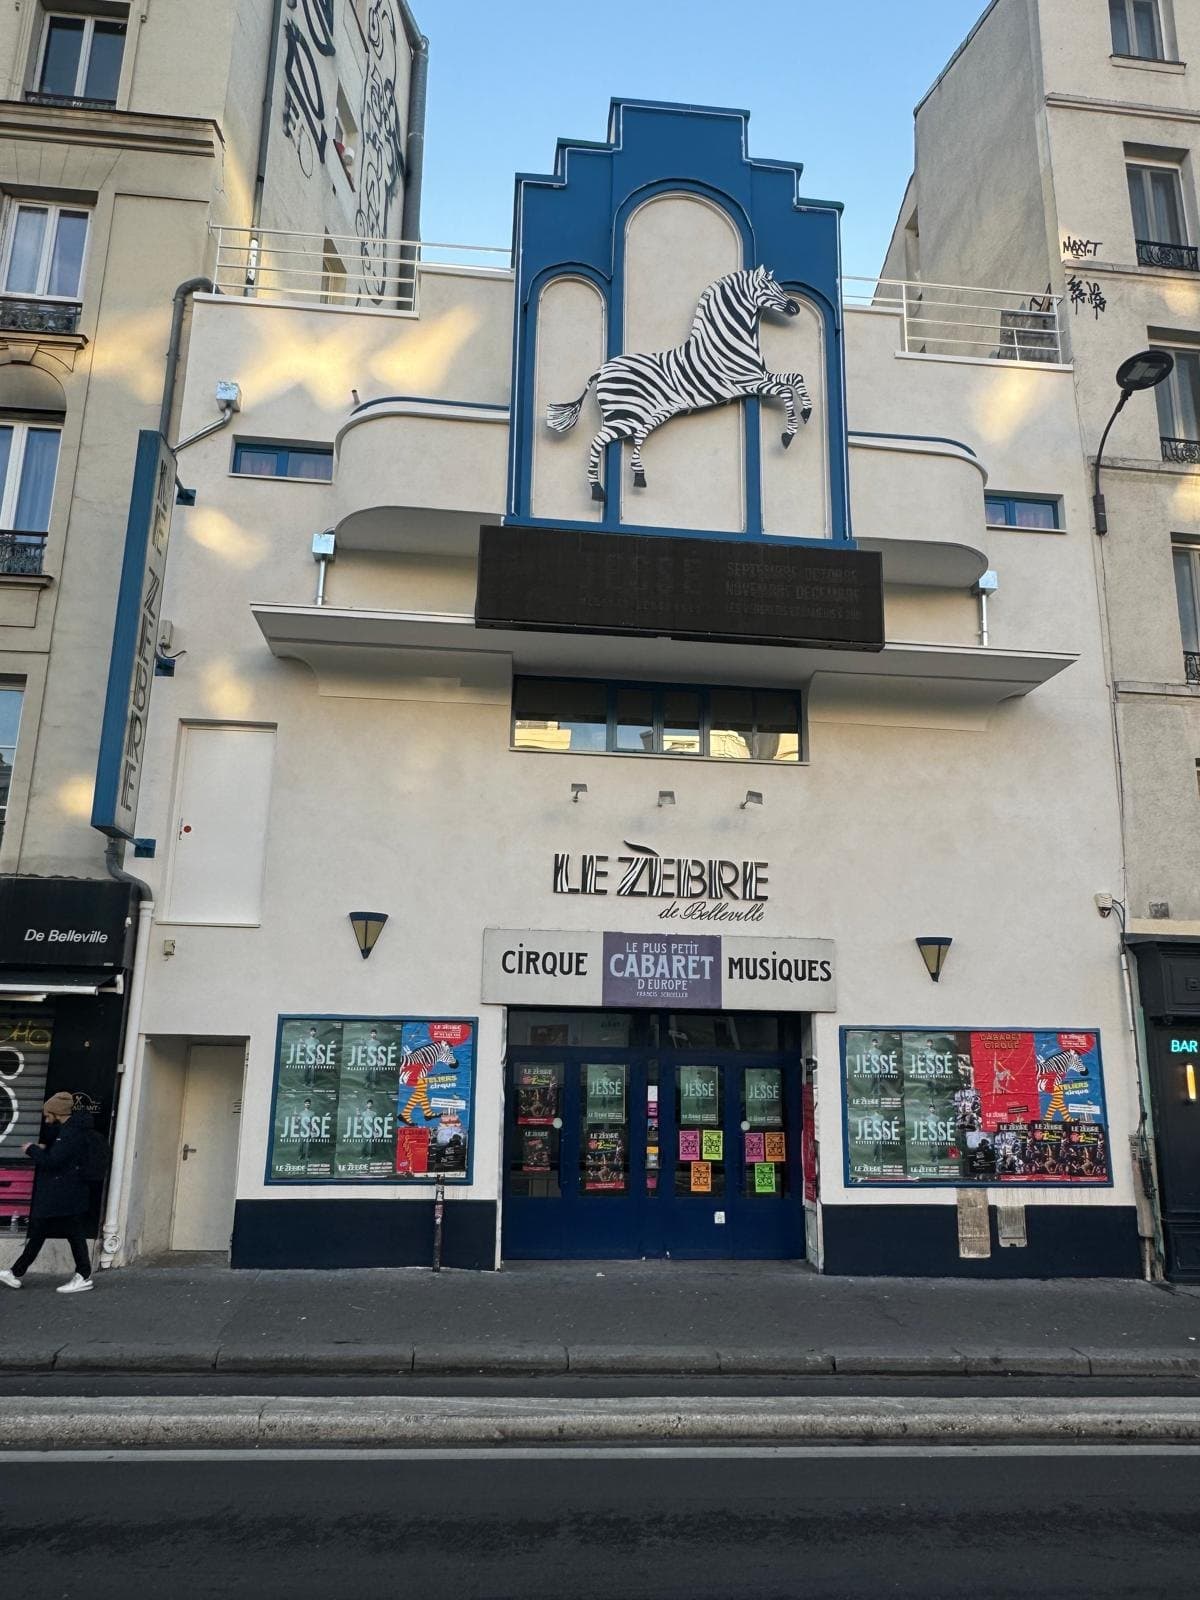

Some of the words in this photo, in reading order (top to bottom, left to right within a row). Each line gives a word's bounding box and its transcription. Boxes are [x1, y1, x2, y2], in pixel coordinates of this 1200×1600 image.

[553, 853, 609, 895] LE
[617, 840, 769, 901] ZÈBRE
[657, 901, 678, 919] de
[679, 901, 765, 921] Belleville
[24, 929, 45, 941] De
[48, 930, 108, 943] Belleville
[626, 942, 638, 953] LE
[643, 943, 667, 954] PLUS
[671, 941, 699, 955] PETIT
[501, 943, 589, 978] CIRQUE
[609, 953, 714, 980] CABARET
[727, 950, 832, 983] MUSIQUES
[286, 1040, 337, 1065] JESSÉ
[347, 1042, 398, 1067] JESSÉ
[1171, 1040, 1198, 1053] BAR
[853, 1051, 899, 1074] JESSÉ
[909, 1051, 953, 1075] JESSÉ
[590, 1079, 622, 1096] JESSÉ
[683, 1080, 715, 1097] JESSÉ
[748, 1082, 780, 1099] JESSÉ
[280, 1112, 332, 1138] JESSÉ
[343, 1112, 394, 1138] JESSÉ
[855, 1116, 901, 1141] JESSÉ
[910, 1117, 956, 1142] JESSÉ
